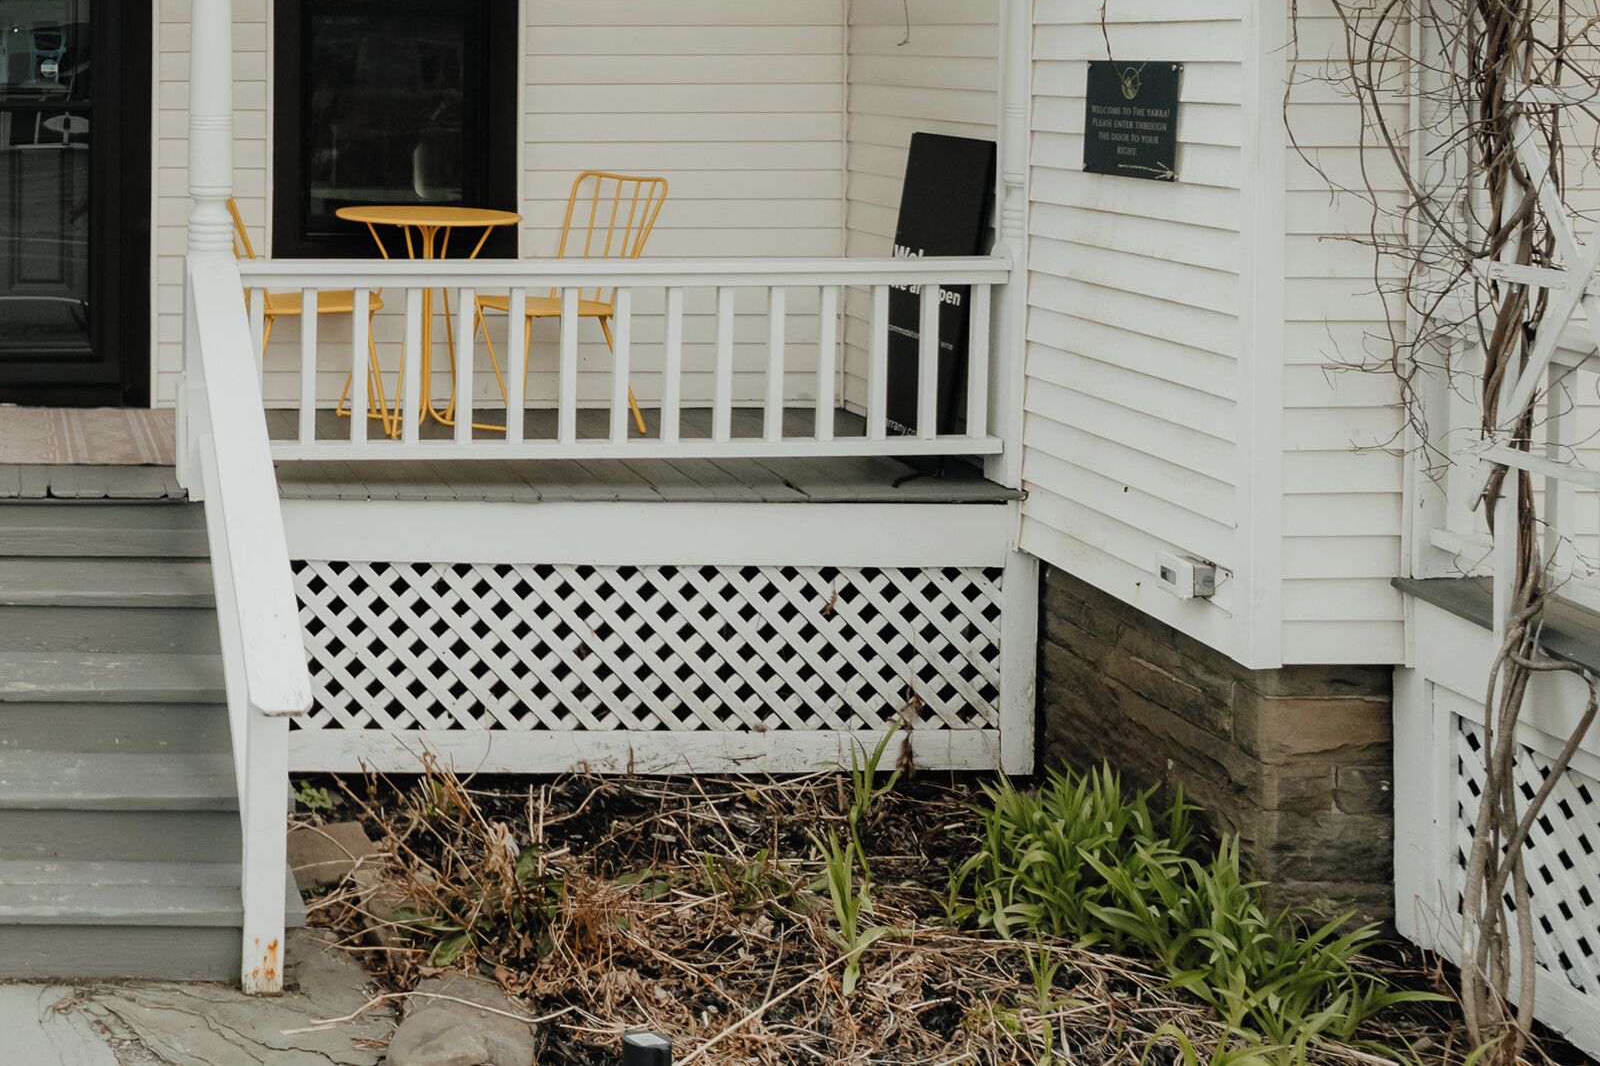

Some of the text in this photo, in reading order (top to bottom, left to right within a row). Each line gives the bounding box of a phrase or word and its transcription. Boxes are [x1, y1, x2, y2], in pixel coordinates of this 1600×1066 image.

[1091, 105, 1121, 115] WELCOME
[1122, 107, 1132, 115] TO
[1132, 106, 1146, 116] THE
[1092, 117, 1167, 131] PLEASE ENTER THROUGH
[1098, 131, 1159, 144] THE DOOR TO YOUR
